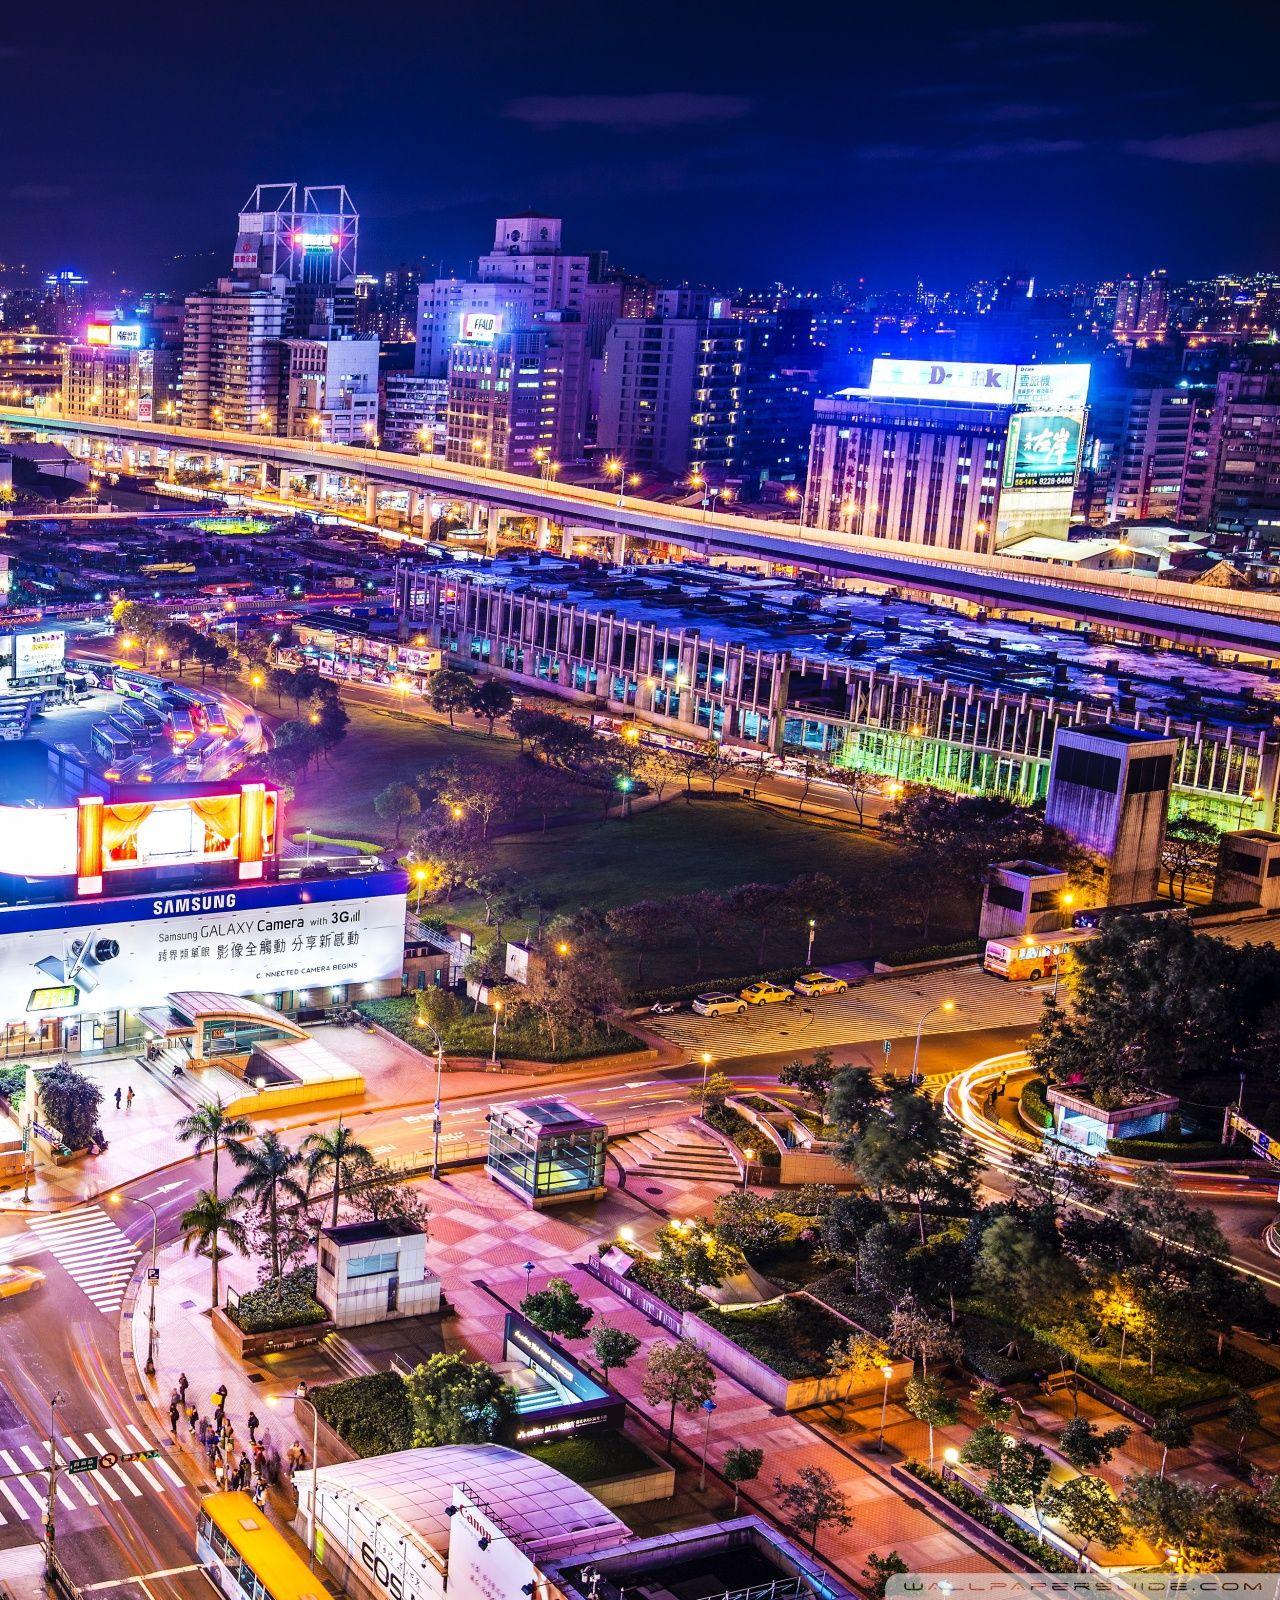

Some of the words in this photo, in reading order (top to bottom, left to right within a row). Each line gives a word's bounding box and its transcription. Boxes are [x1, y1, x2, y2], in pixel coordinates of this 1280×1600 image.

[153, 893, 237, 915] SAMSUNG
[158, 931, 198, 943] Samsung
[200, 920, 255, 939] GALAXY
[257, 916, 305, 932] Camera
[310, 917, 328, 927] with
[331, 911, 350, 924] 3G
[291, 930, 360, 952] 分享新感動
[301, 964, 331, 975] CAMERA
[333, 962, 358, 971] BEGINS
[459, 1504, 492, 1544] Canon
